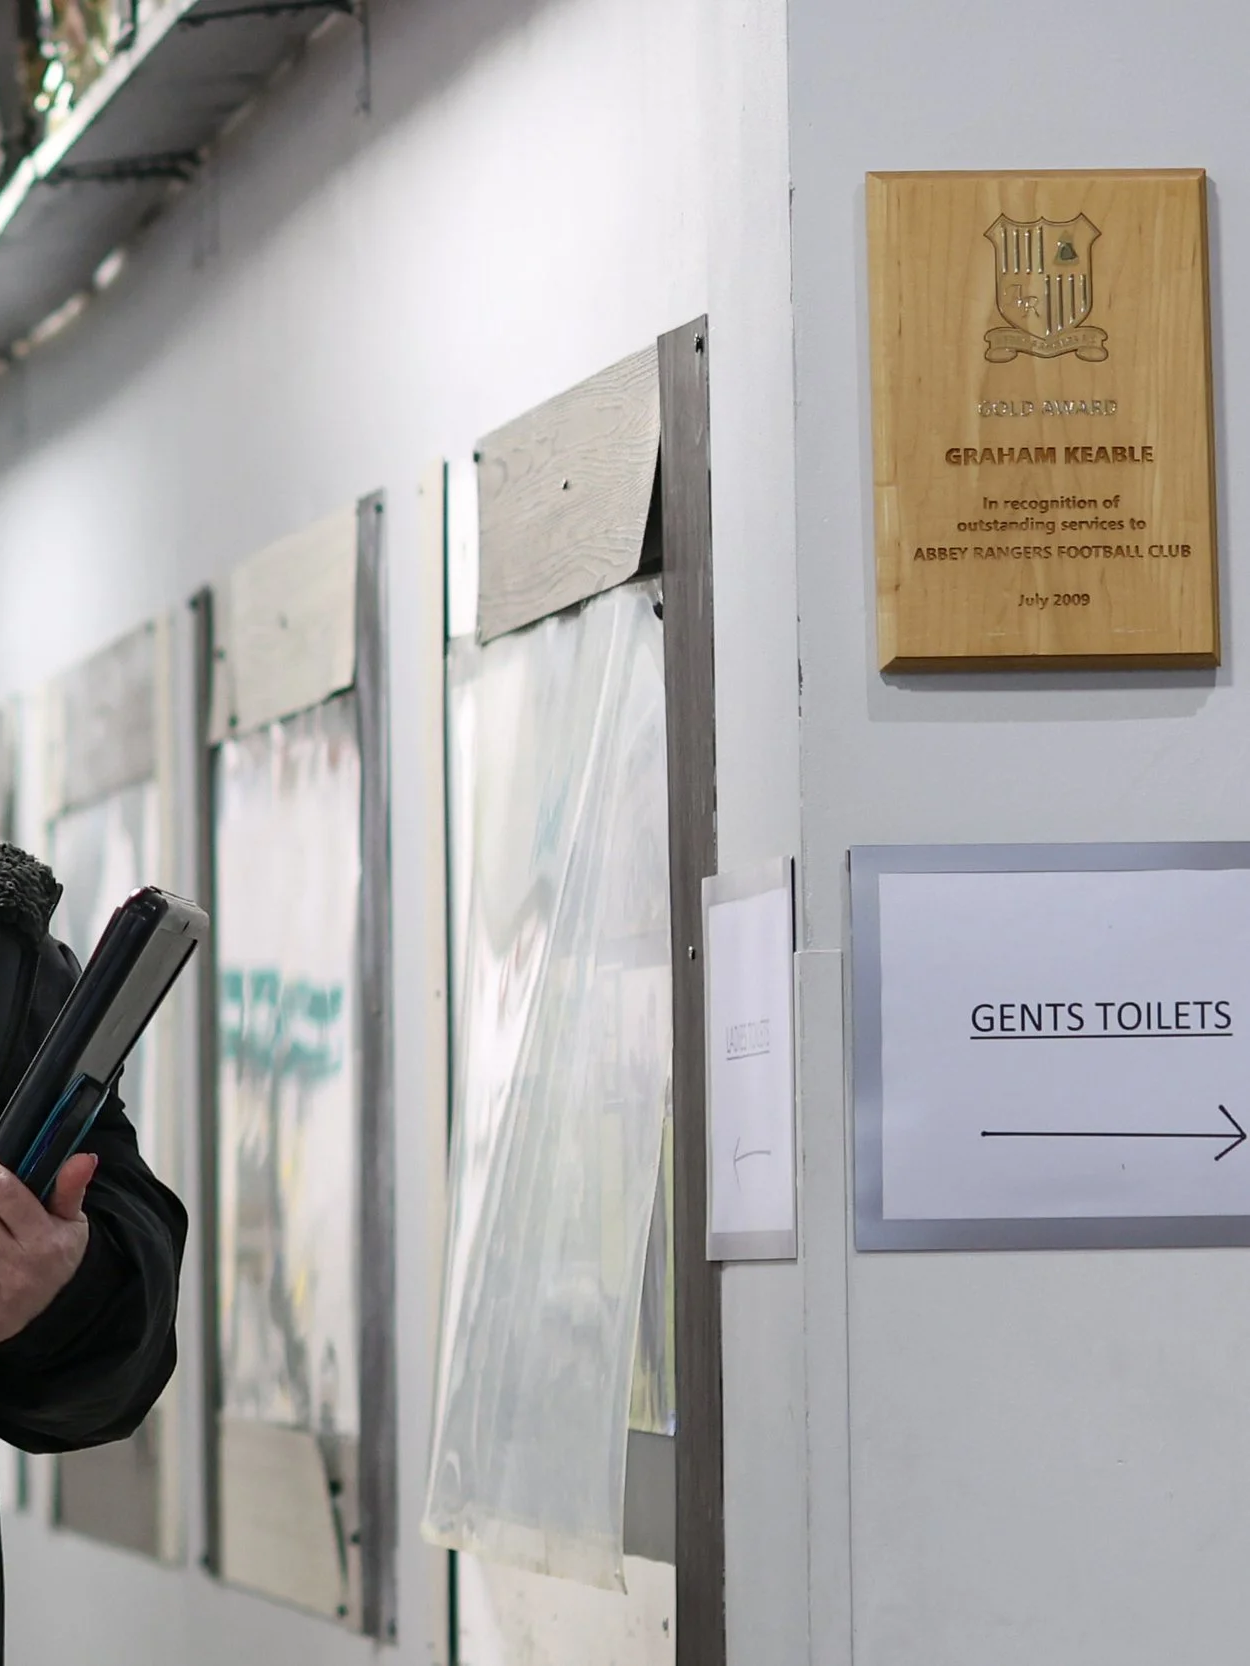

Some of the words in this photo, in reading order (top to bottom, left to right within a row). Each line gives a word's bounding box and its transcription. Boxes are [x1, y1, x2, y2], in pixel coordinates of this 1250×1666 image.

[977, 400, 1034, 417] GOLD
[1042, 400, 1118, 416] AWARD
[945, 447, 1056, 465] GRAHAM
[1064, 446, 1154, 463] KEABLE
[982, 497, 998, 510] In
[1004, 495, 1098, 513] recognition
[1102, 495, 1121, 509] of
[957, 517, 1055, 535] outstanding
[1061, 516, 1125, 531] services
[1129, 517, 1147, 530] to
[913, 546, 968, 560] ABBEY
[973, 545, 1052, 560] RANGERS
[1057, 544, 1144, 558] FOOTBALL
[1148, 544, 1192, 557] CLUB
[1018, 592, 1049, 609] July
[1053, 593, 1091, 606] 2009
[971, 1003, 1085, 1032] GENTS
[1095, 1001, 1232, 1031] TOILETS
